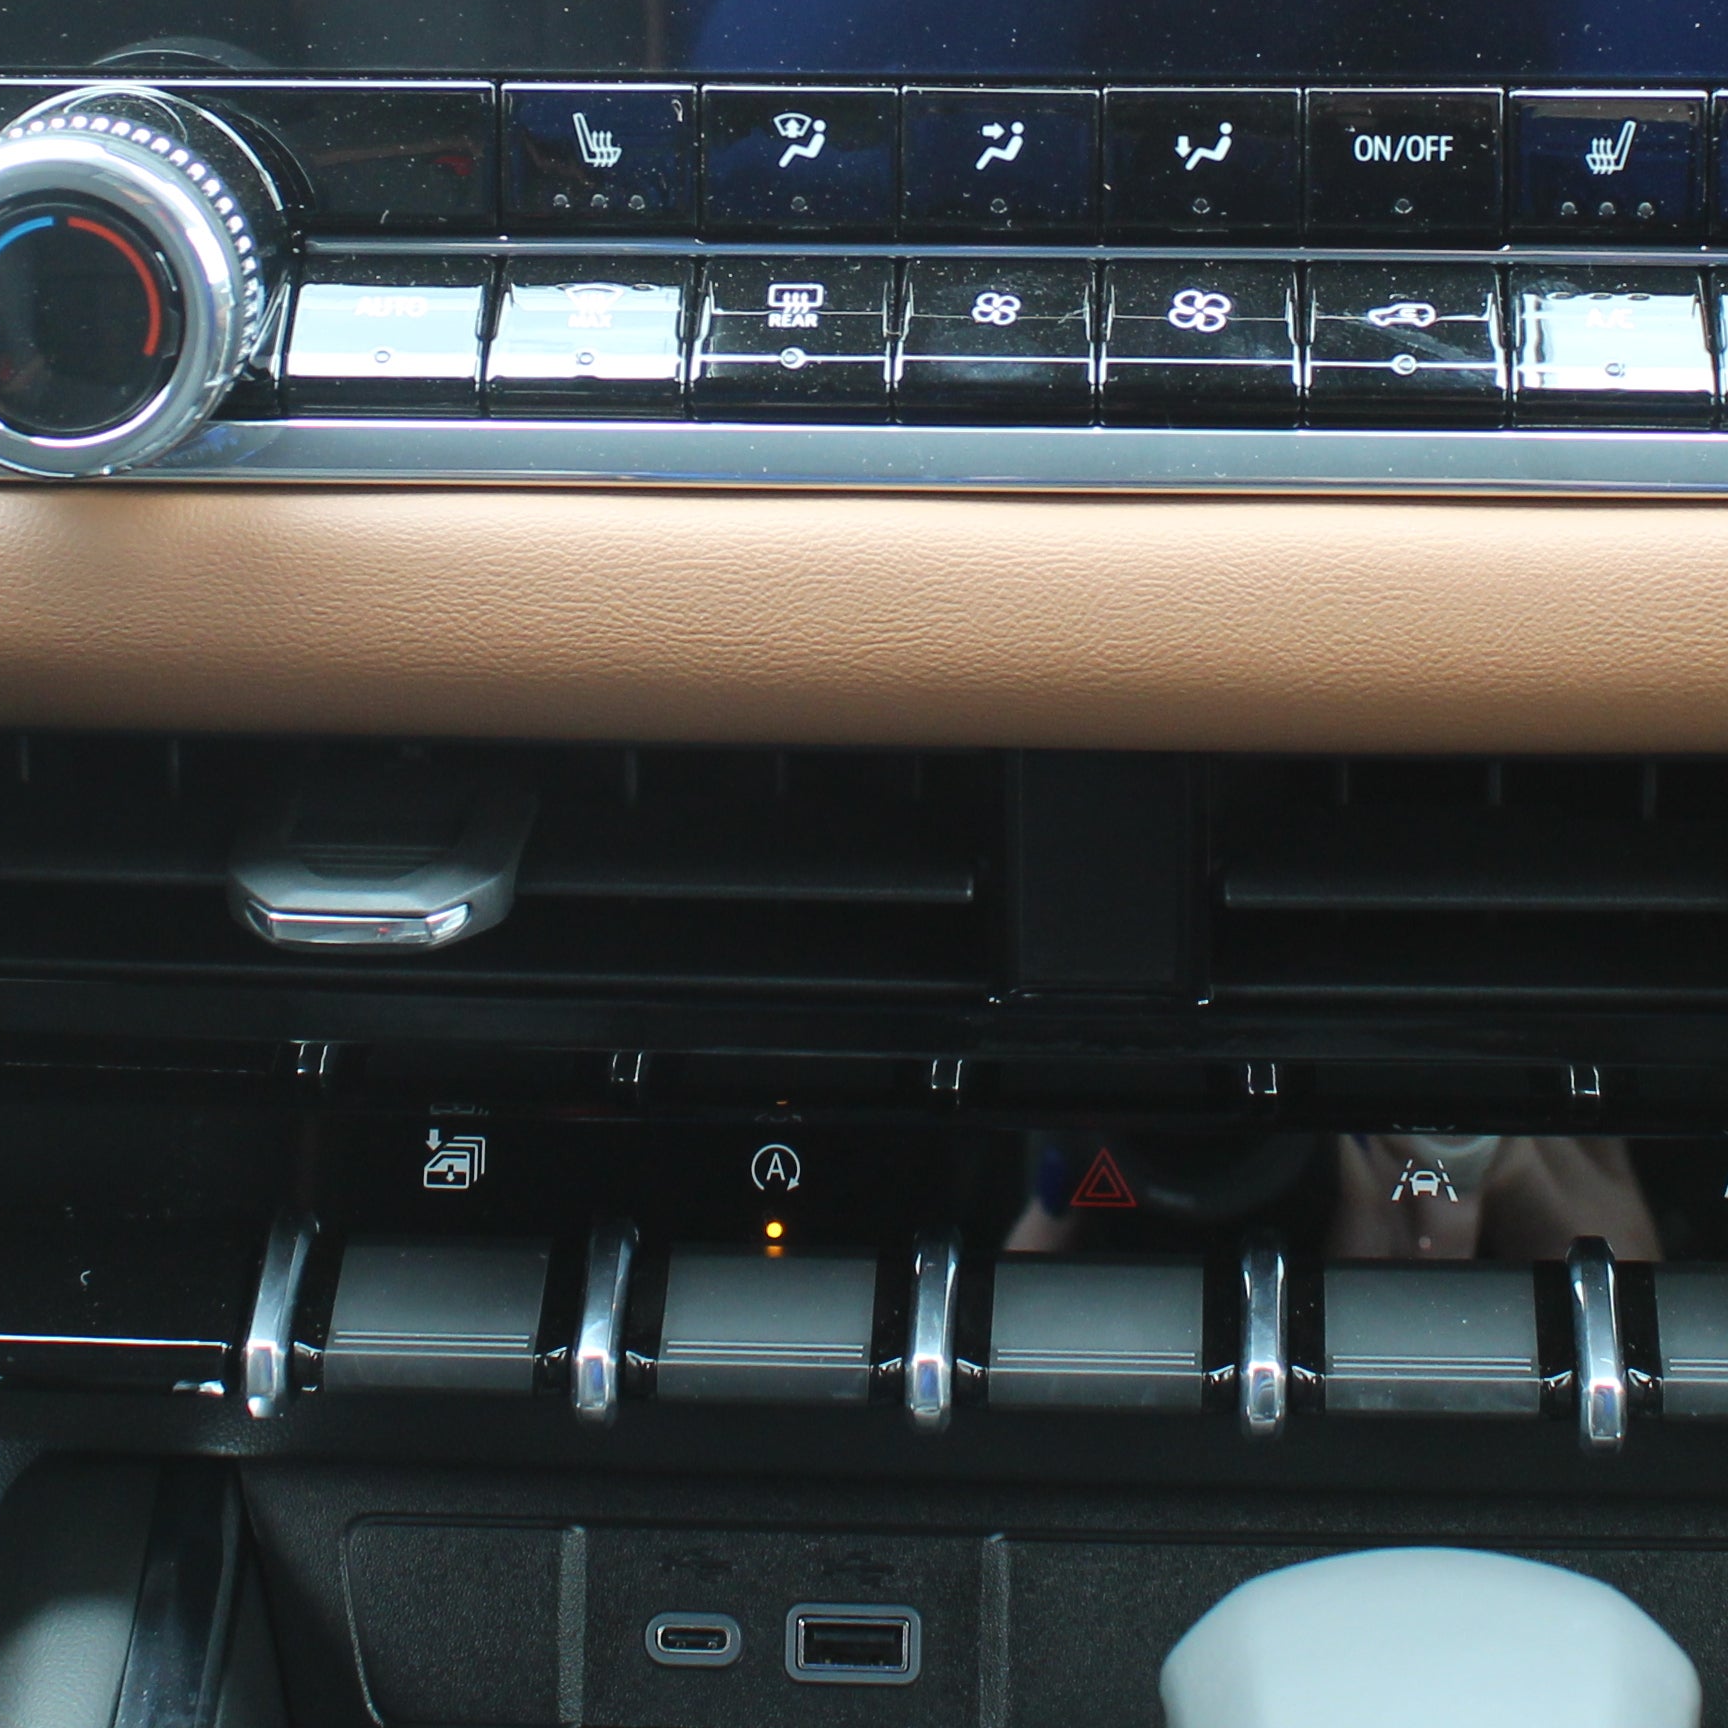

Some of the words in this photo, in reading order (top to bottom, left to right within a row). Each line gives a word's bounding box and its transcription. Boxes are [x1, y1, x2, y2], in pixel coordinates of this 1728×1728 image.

[1354, 134, 1454, 162] ON/OFF
[354, 296, 429, 318] AUTO
[768, 313, 819, 328] REAR
